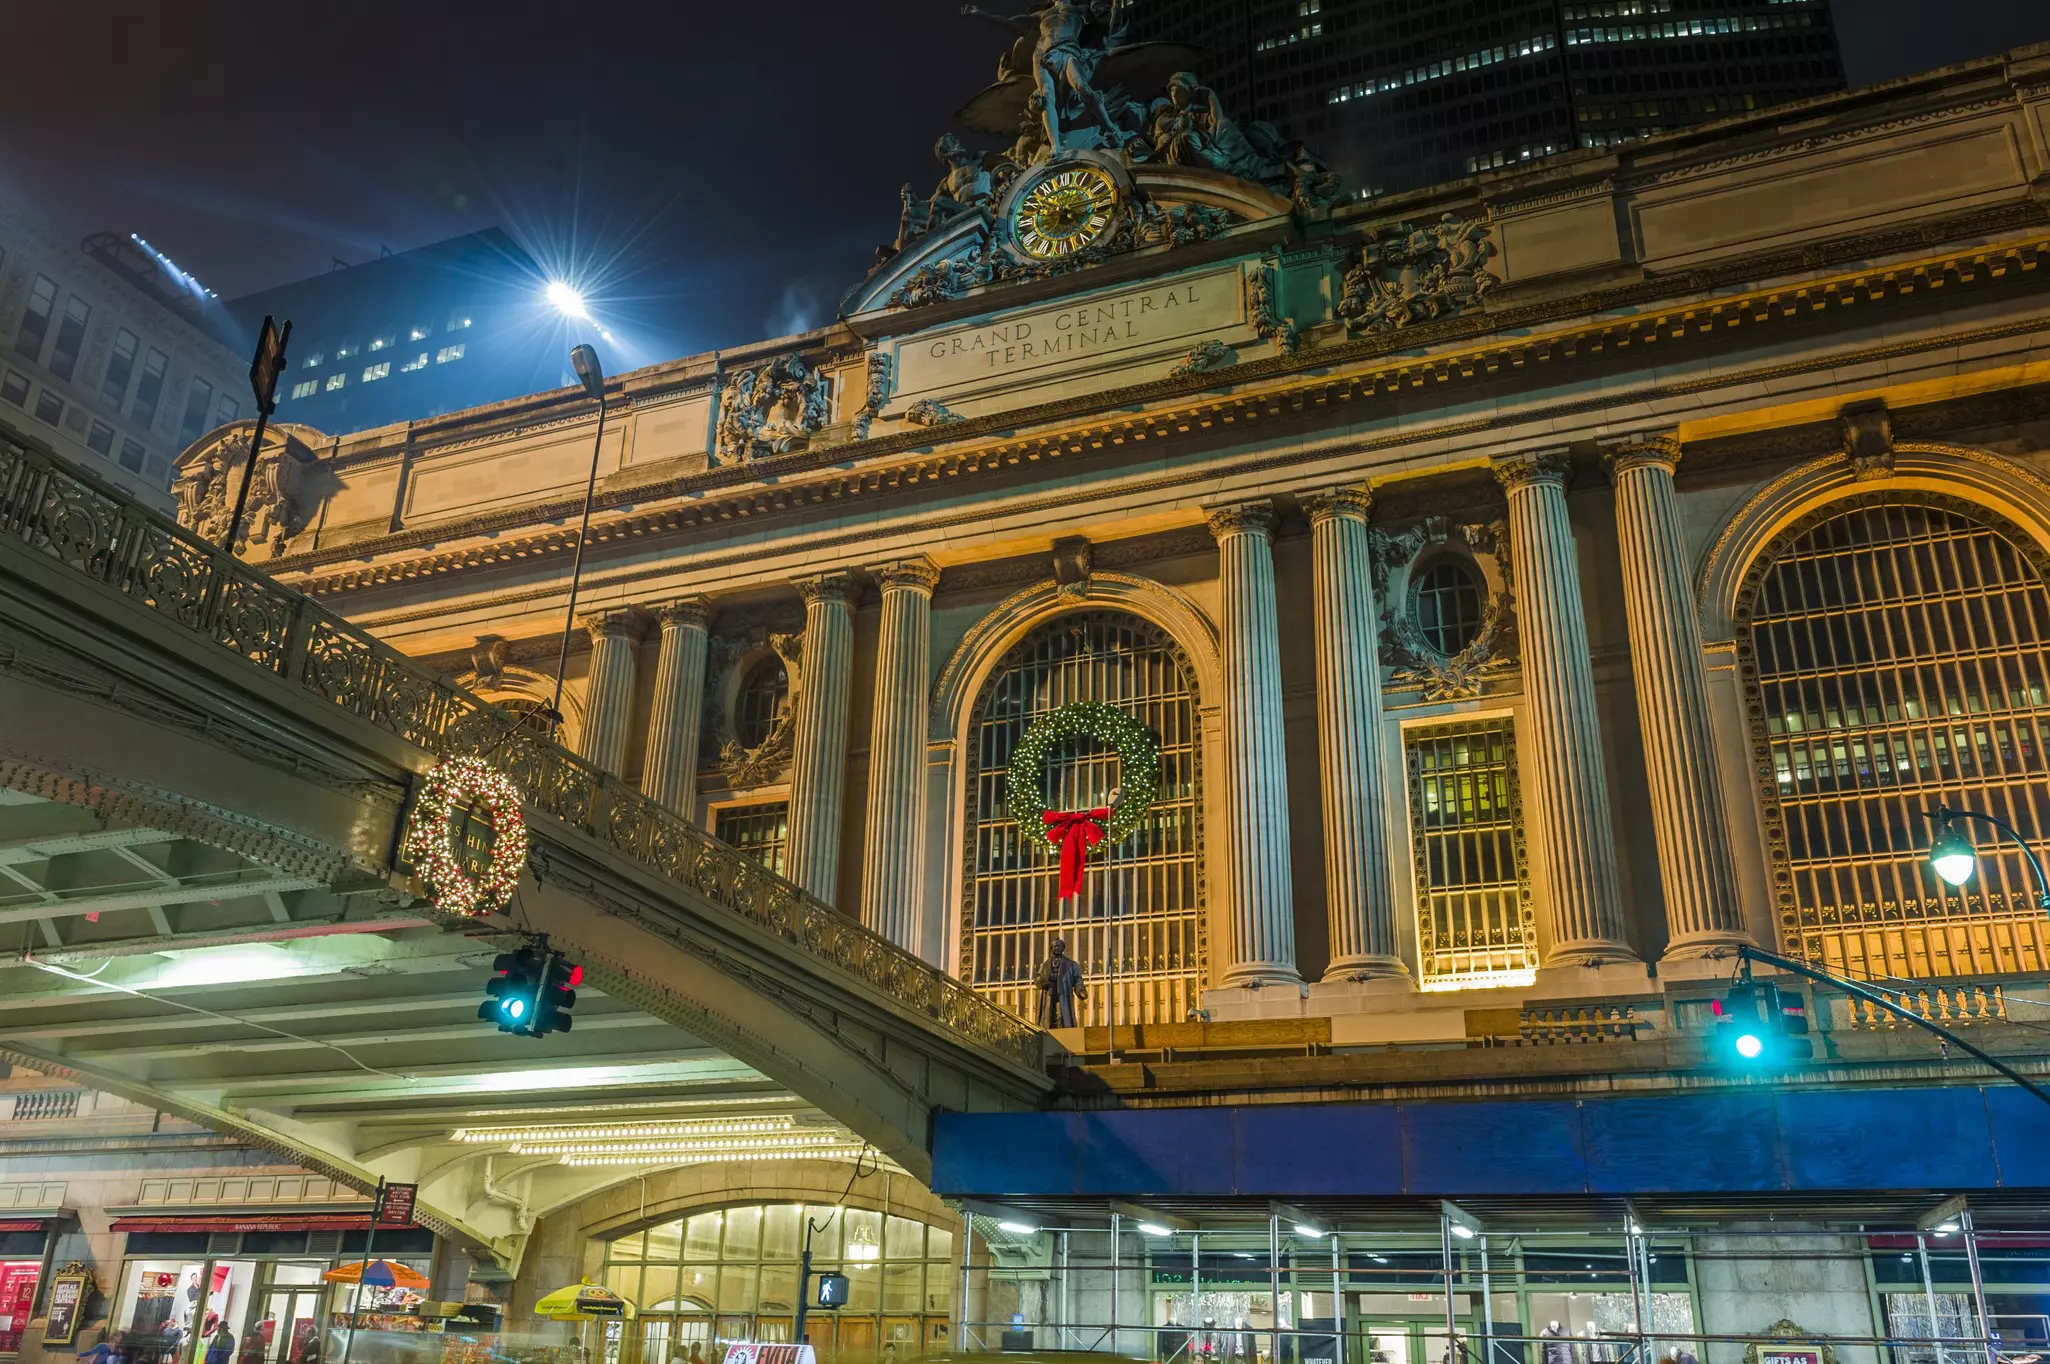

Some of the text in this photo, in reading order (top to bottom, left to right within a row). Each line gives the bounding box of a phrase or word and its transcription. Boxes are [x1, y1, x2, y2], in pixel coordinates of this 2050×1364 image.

[930, 286, 1201, 358] GRAND CENTRAL
[985, 320, 1140, 367] TERMINAL
[756, 1346, 800, 1364] EVITA
[1764, 1356, 1791, 1364] GIFTS
